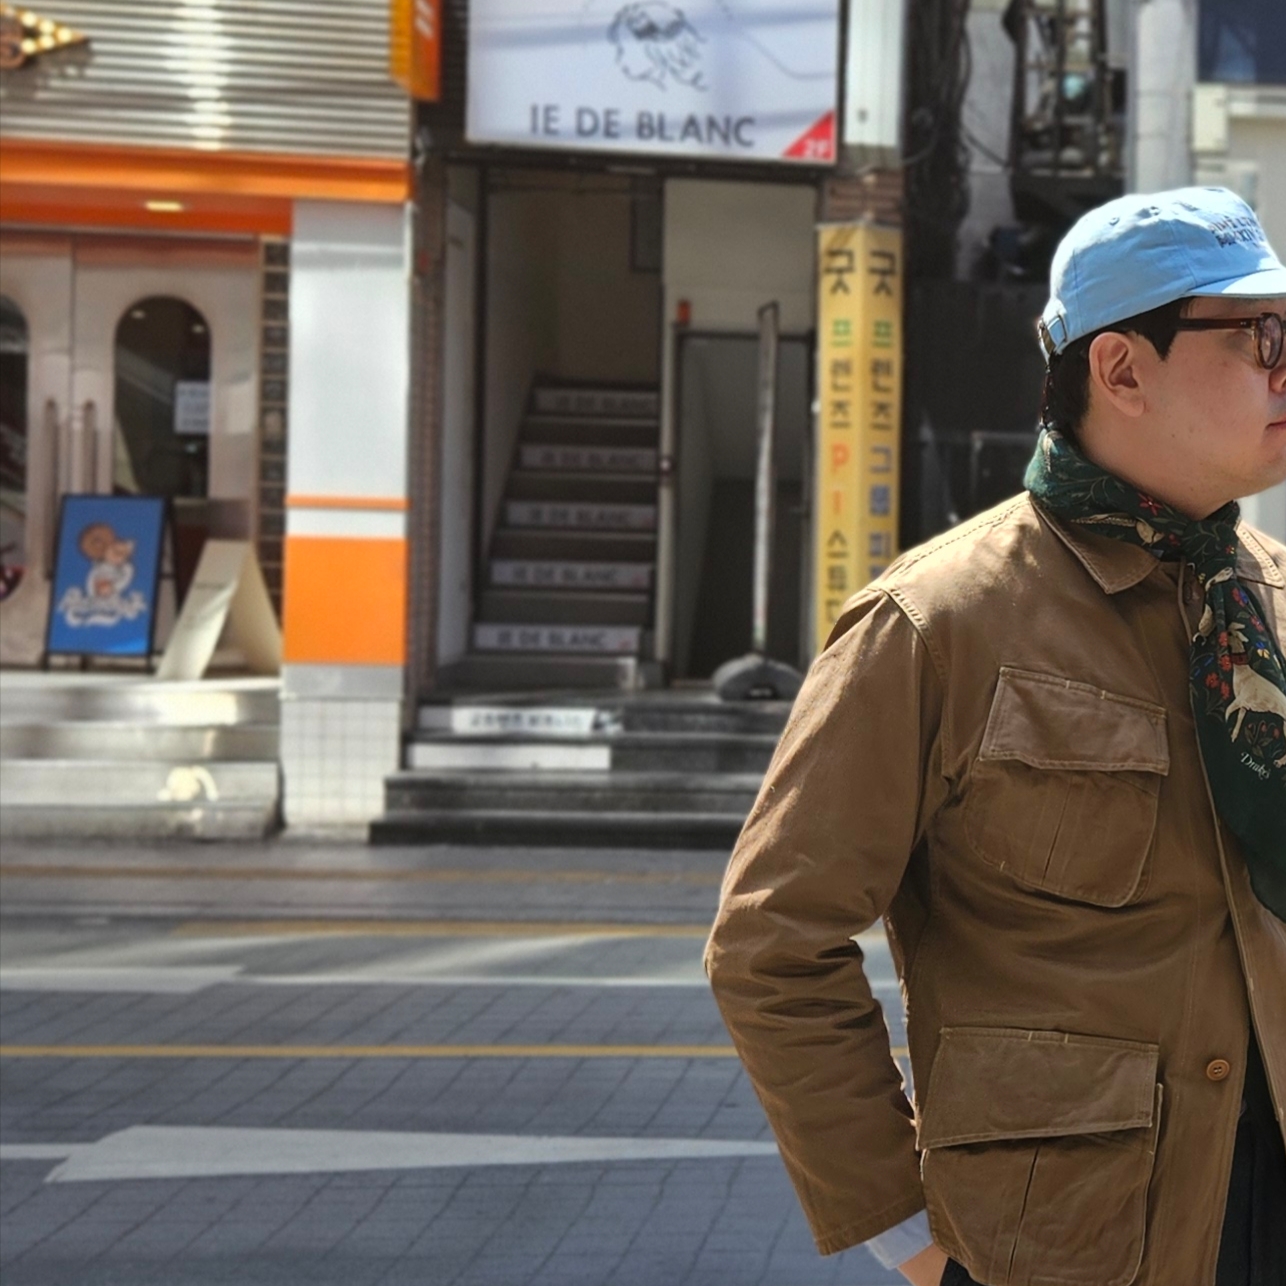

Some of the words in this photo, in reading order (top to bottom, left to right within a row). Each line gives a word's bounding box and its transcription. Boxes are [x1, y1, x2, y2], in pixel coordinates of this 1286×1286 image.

[530, 104, 560, 136] IE
[575, 107, 620, 139] DE
[636, 111, 755, 147] BLANC
